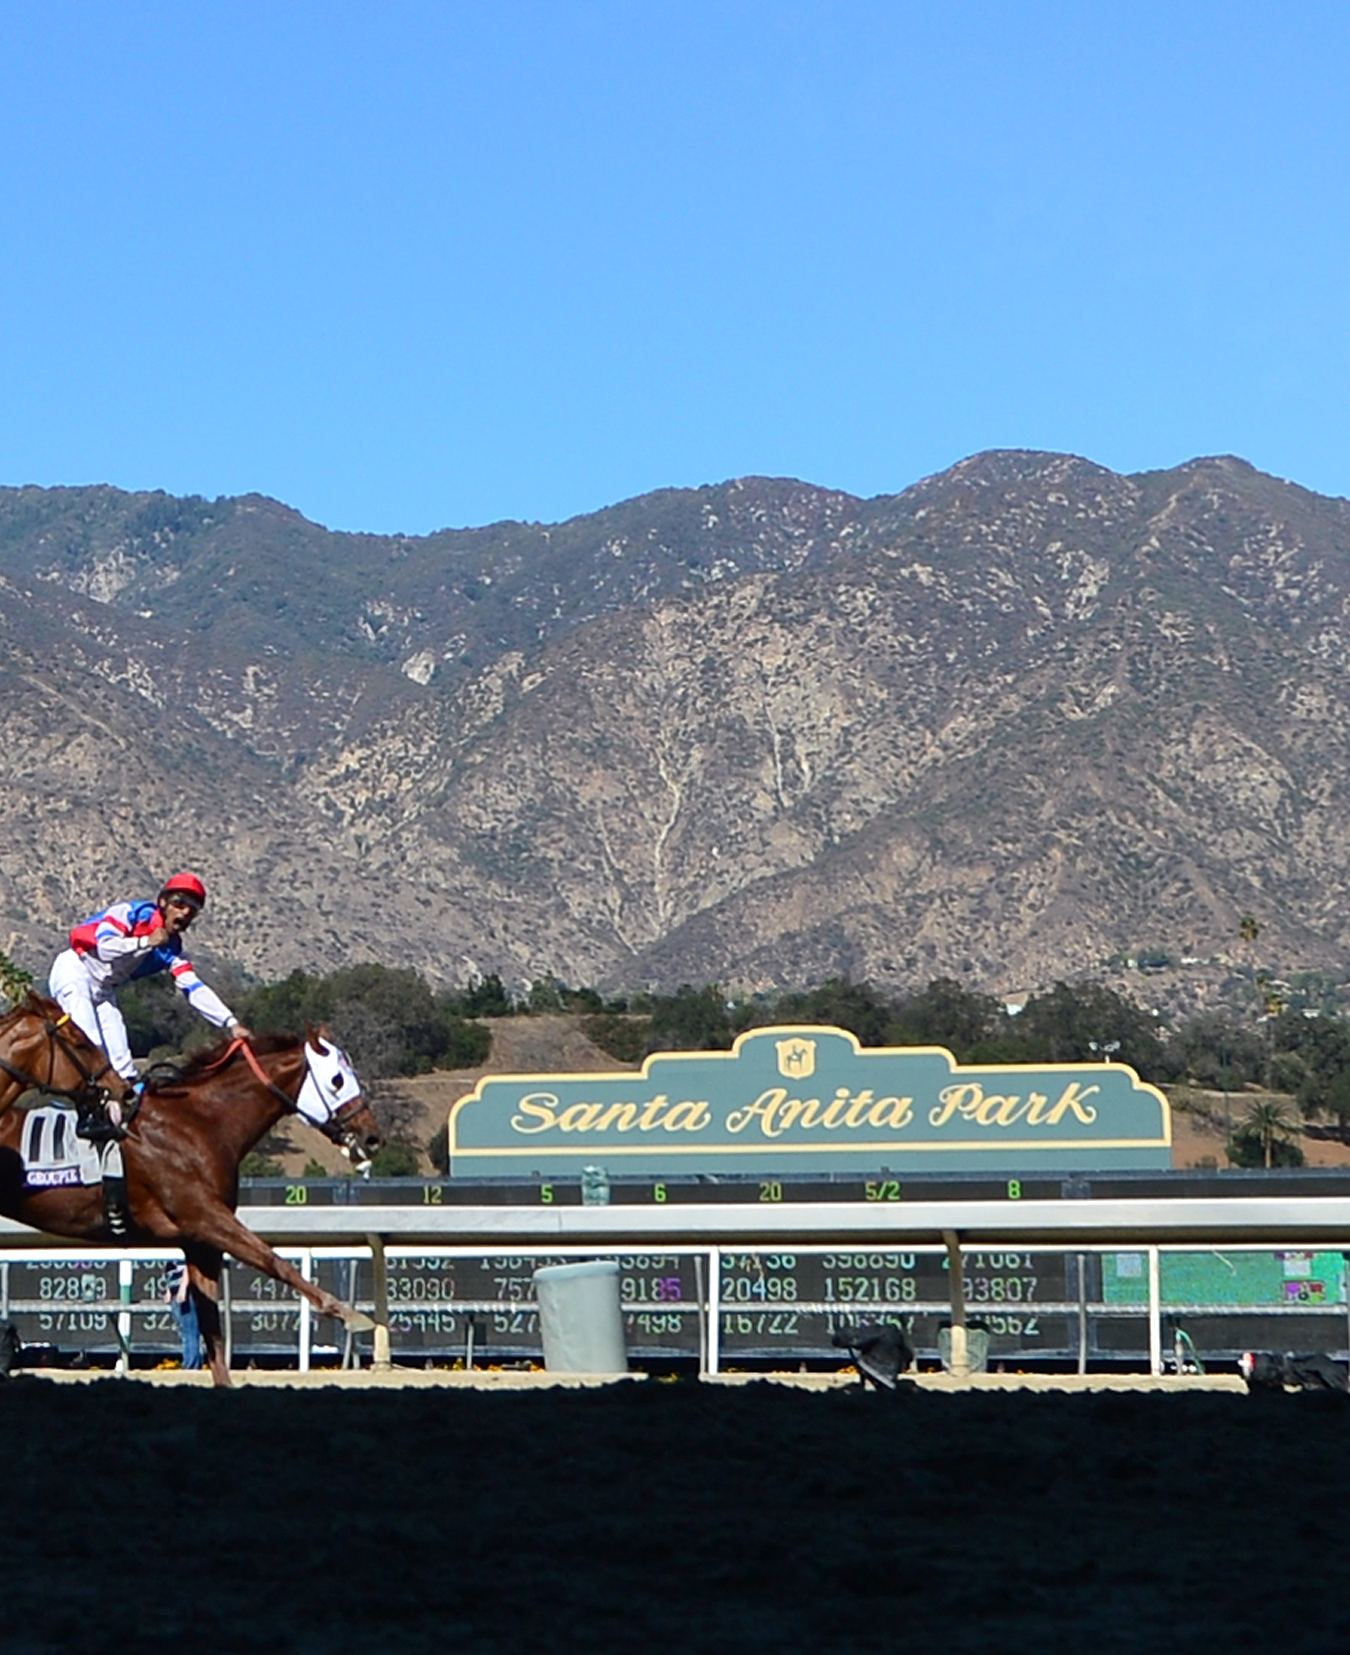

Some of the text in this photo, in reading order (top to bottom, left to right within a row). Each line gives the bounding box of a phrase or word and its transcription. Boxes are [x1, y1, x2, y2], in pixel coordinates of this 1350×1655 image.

[510, 1092, 711, 1134] Santa
[725, 1087, 913, 1138] Anita
[28, 1112, 67, 1163] 11
[285, 1180, 1021, 1204] 20 12 5 6 20 5/2 8
[39, 1276, 107, 1299] 8289
[721, 1276, 798, 1301] 20498
[823, 1276, 917, 1301] 152168
